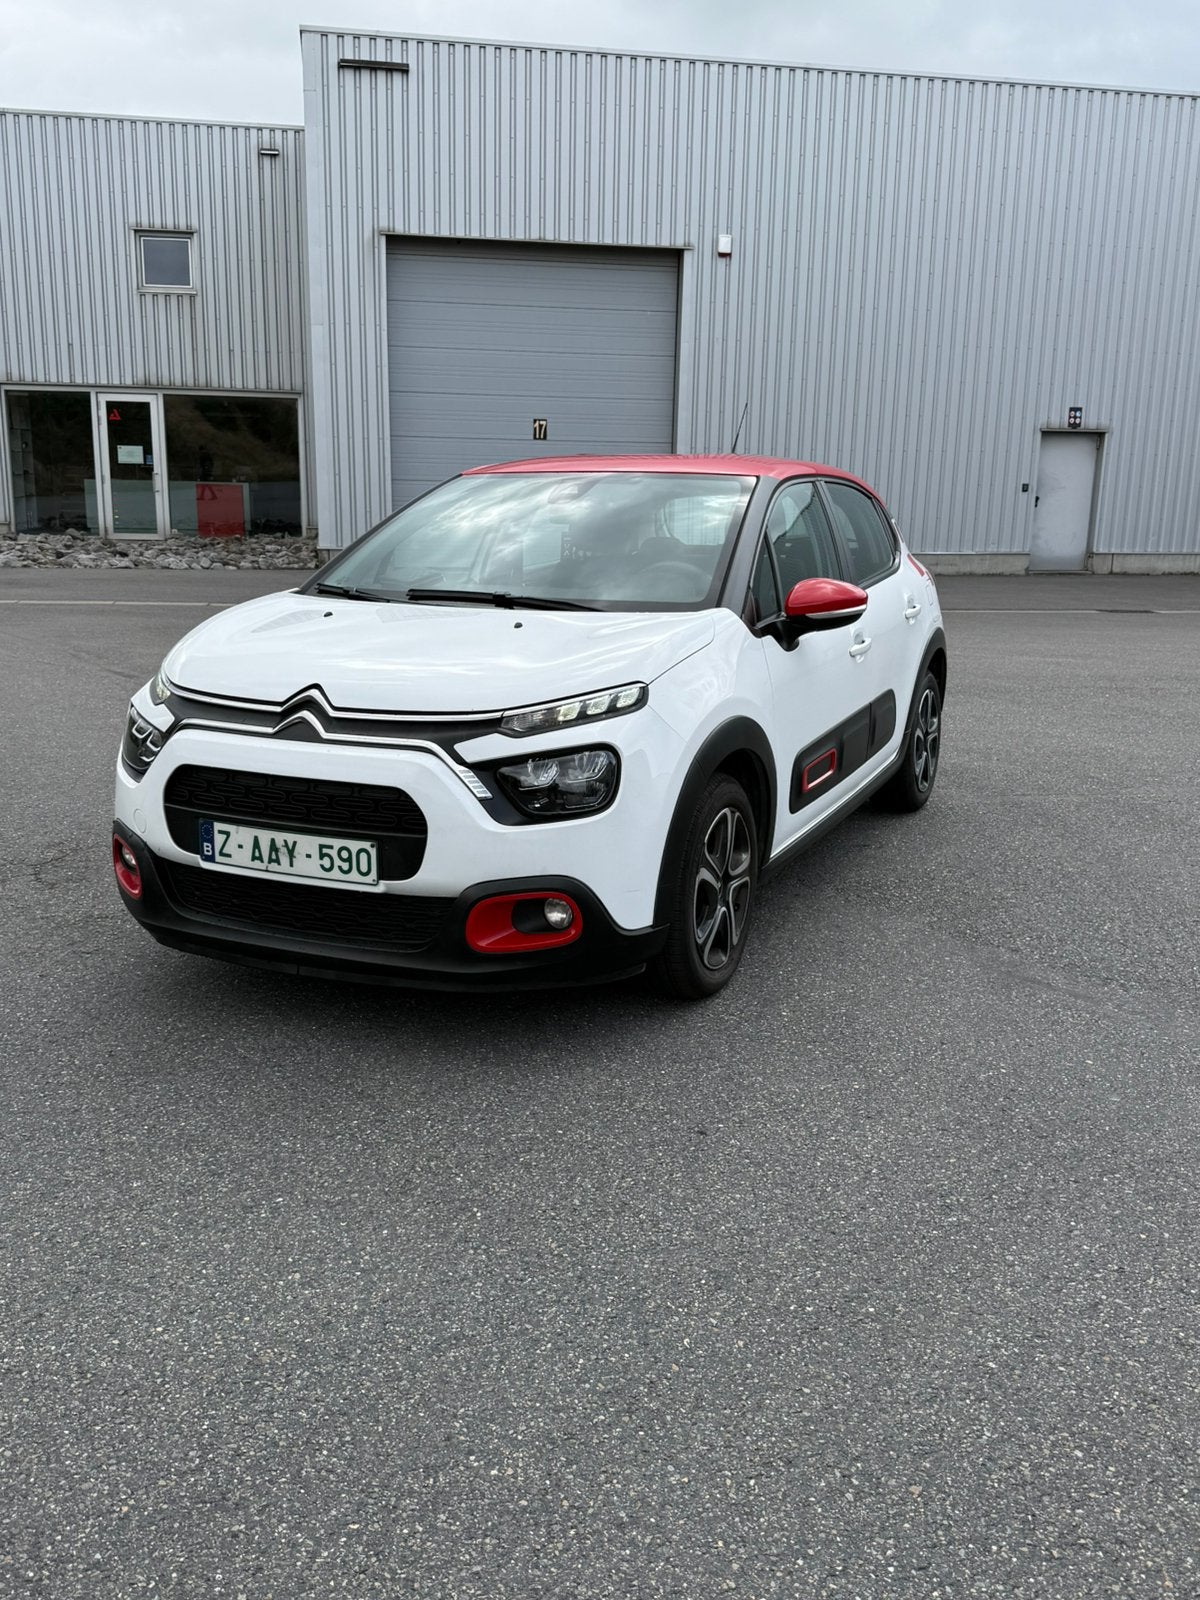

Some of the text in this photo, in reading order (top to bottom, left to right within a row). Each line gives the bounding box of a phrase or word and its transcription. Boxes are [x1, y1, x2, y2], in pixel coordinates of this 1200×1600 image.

[534, 420, 547, 439] 17
[203, 829, 372, 877] B Z-AAY-590
